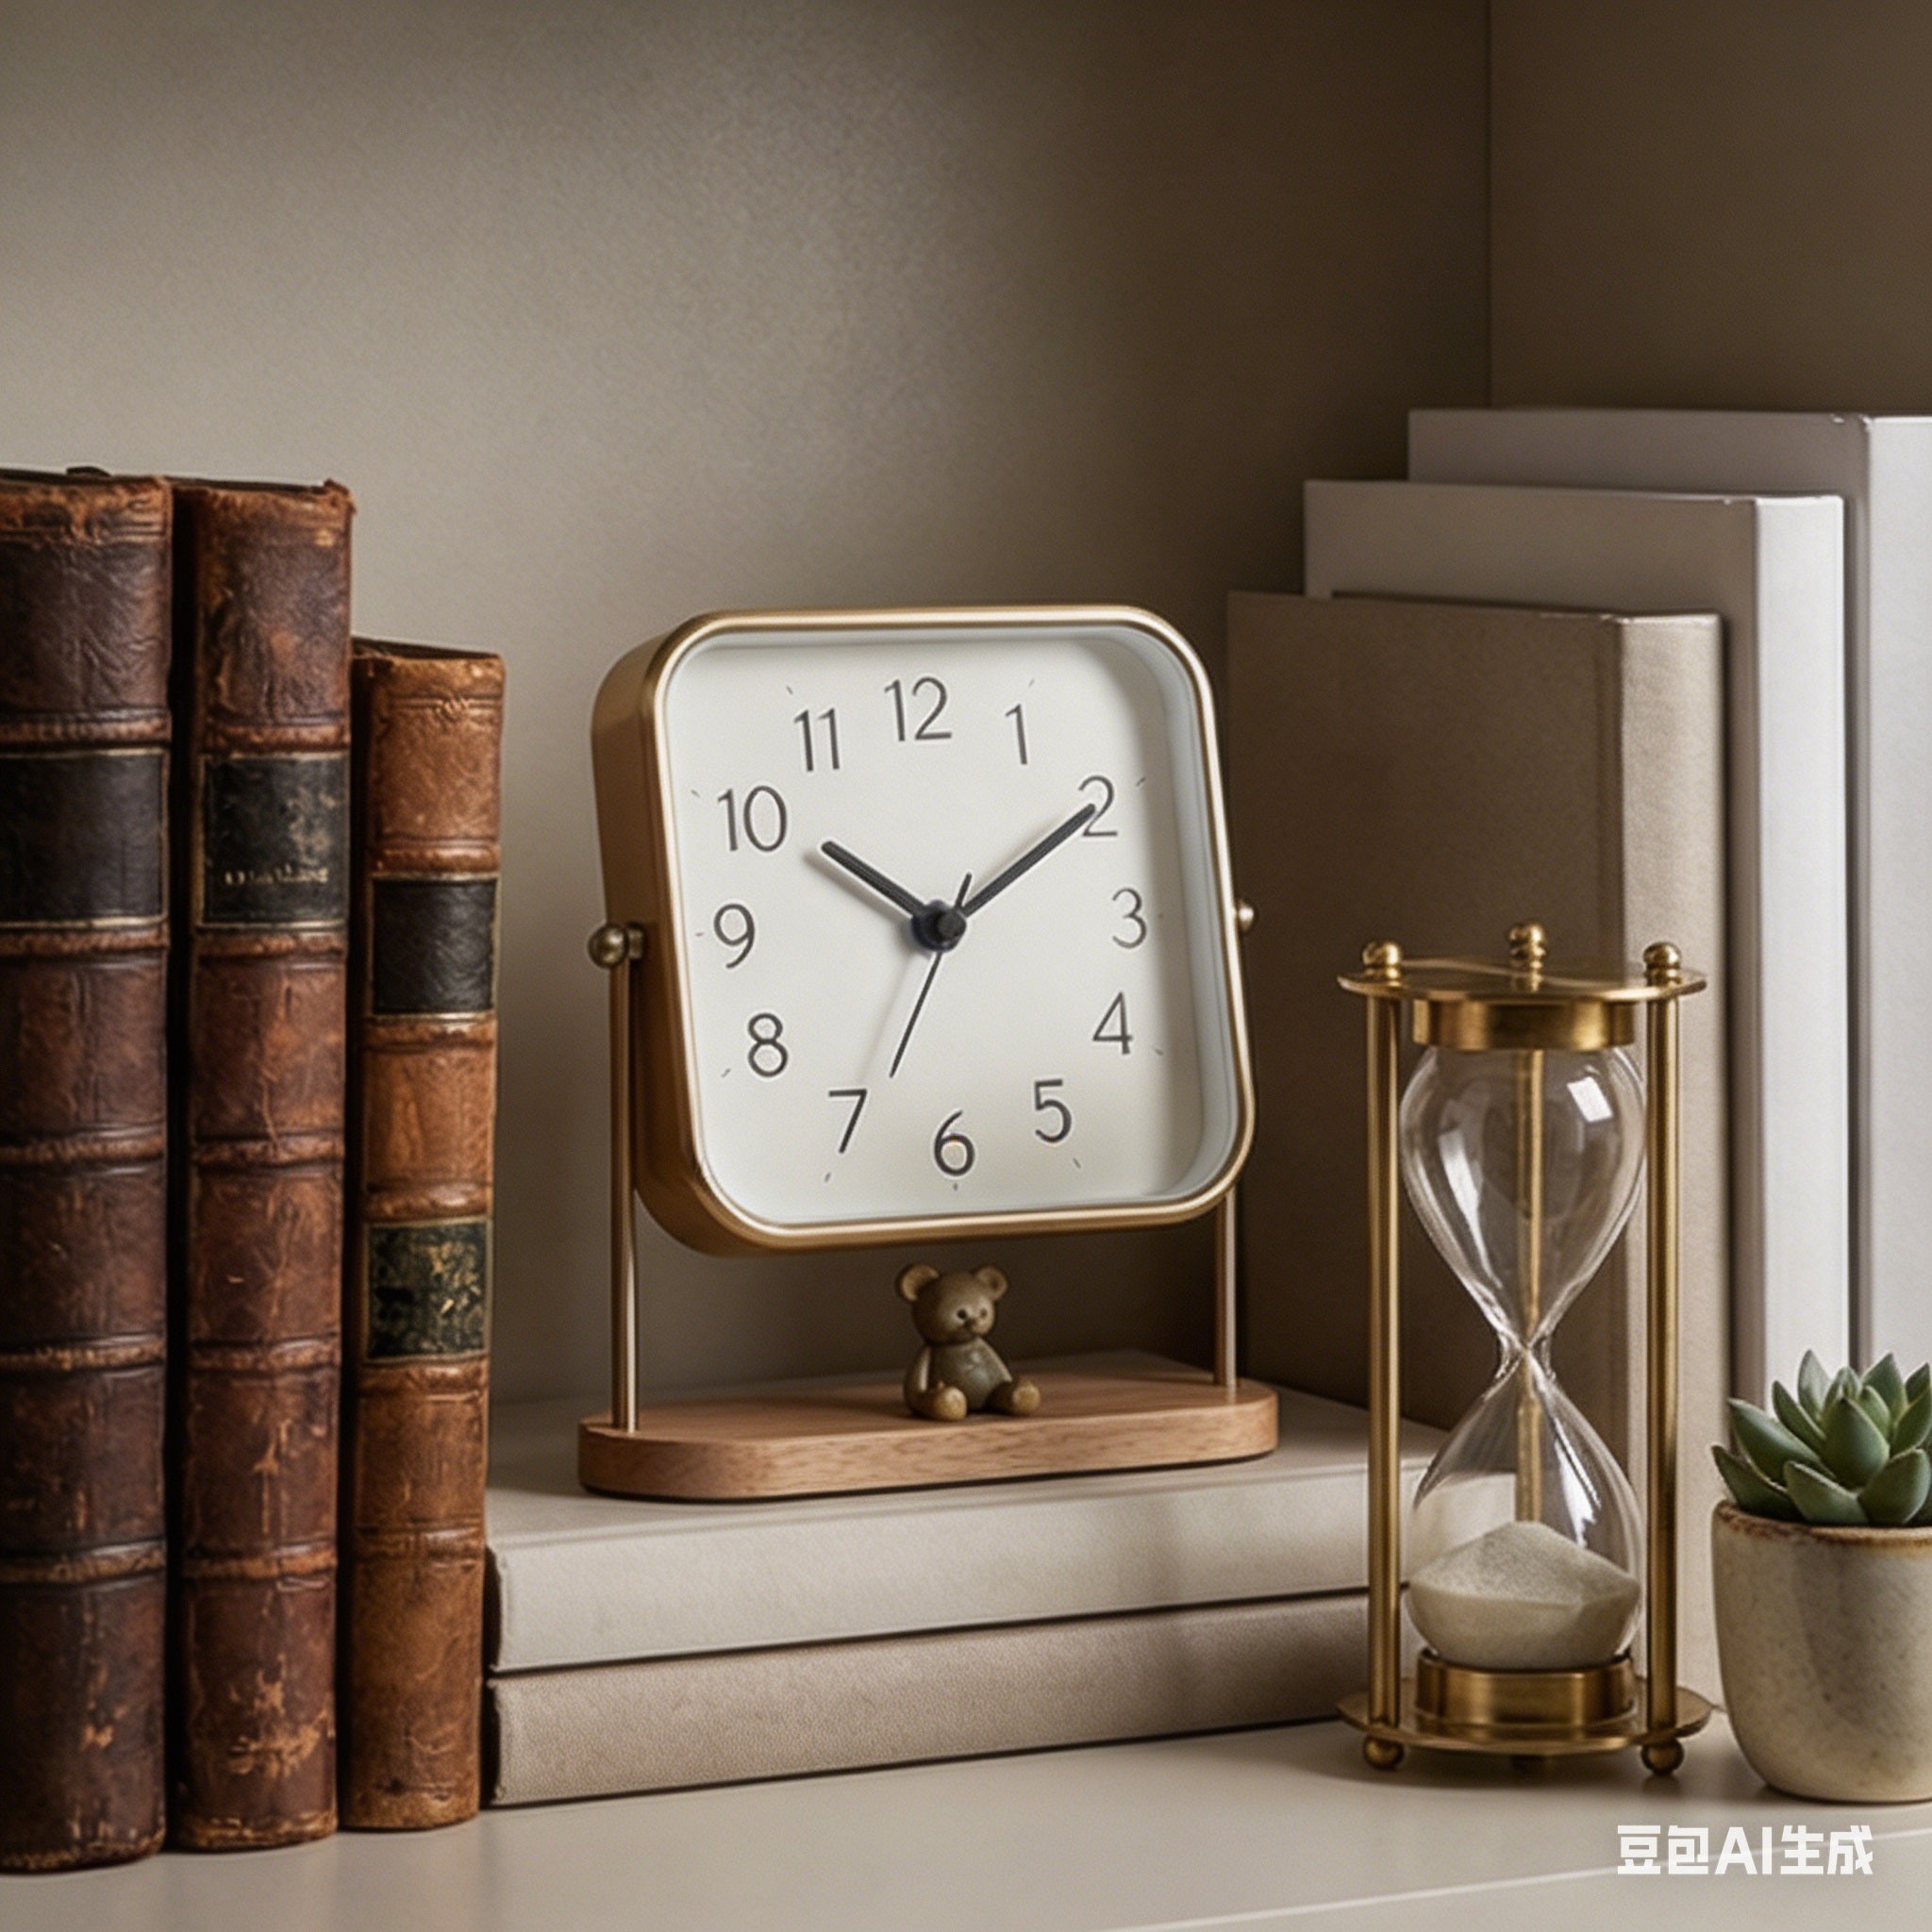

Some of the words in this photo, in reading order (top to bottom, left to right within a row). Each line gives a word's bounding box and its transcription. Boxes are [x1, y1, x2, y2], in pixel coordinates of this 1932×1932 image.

[793, 708, 841, 772] 11
[884, 676, 953, 741] 12
[1005, 704, 1028, 765] 1
[716, 785, 788, 852] 10
[1077, 774, 1118, 838] 2
[713, 903, 756, 969] 9
[1112, 888, 1148, 949] 3
[746, 1012, 789, 1077] 8
[1092, 991, 1134, 1056] 4
[828, 1088, 868, 1155] 7
[933, 1109, 975, 1176] 6
[1034, 1078, 1073, 1143] 5
